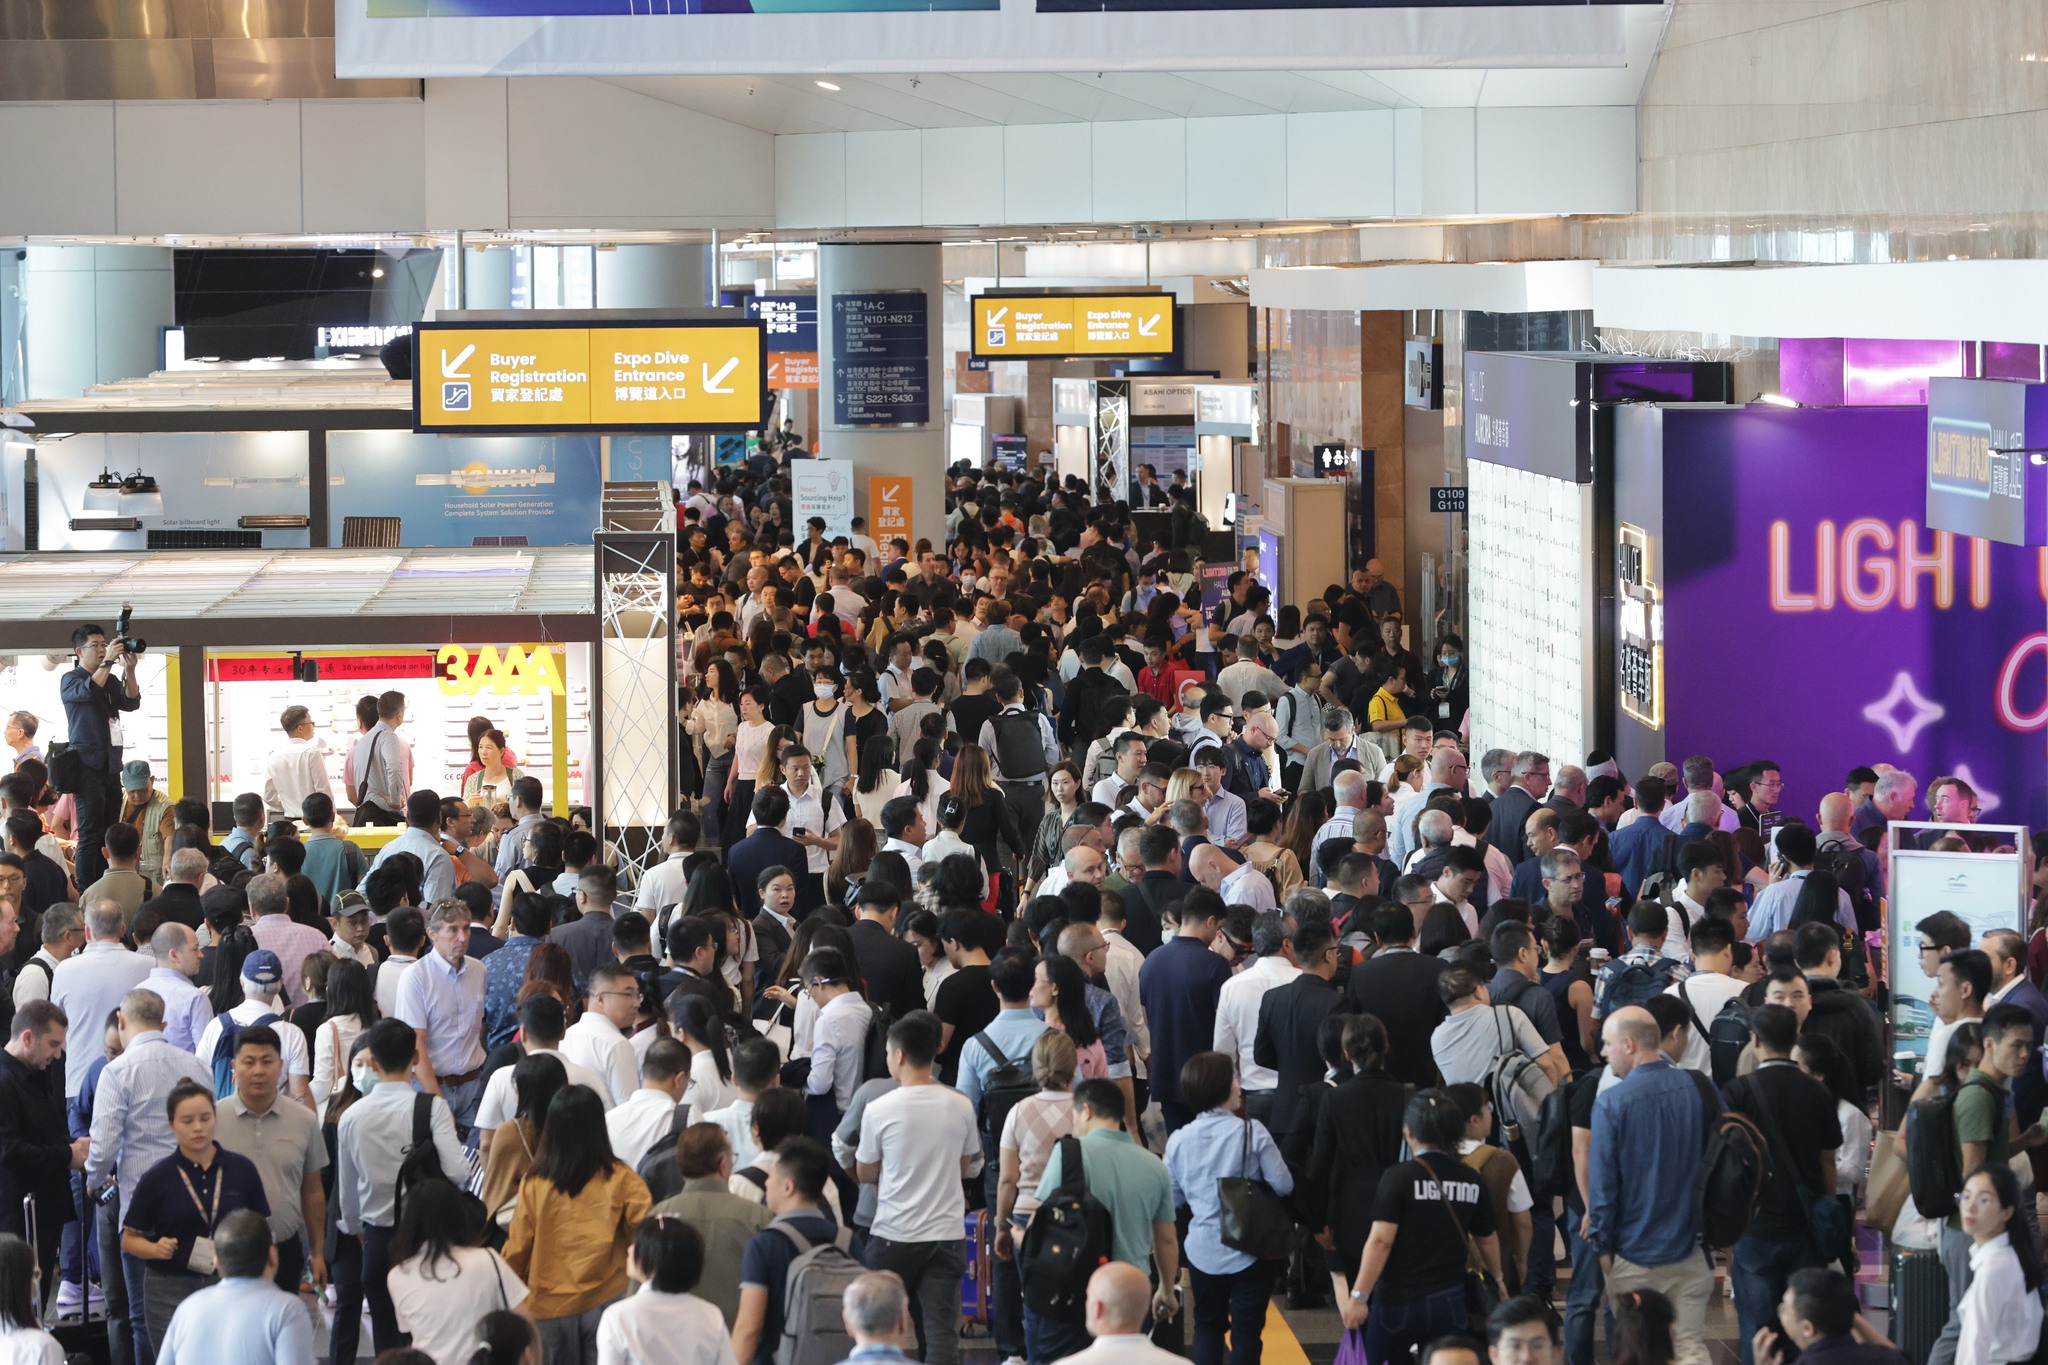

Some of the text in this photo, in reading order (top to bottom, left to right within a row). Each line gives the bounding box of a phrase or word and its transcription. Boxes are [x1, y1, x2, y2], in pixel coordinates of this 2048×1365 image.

[776, 302, 796, 310] 1A-B
[864, 302, 885, 310] 1A-C
[864, 315, 913, 324] N101-N212
[1015, 312, 1043, 322] Buyer
[1087, 310, 1132, 320] Expo Dive
[1015, 322, 1072, 332] Registration
[1087, 321, 1129, 330] Entrance
[490, 353, 536, 367] Buyer
[614, 352, 690, 366] Expo Dive
[784, 358, 810, 366] Buyer
[490, 370, 587, 384] Registration
[614, 369, 685, 382] Entrance
[490, 388, 563, 402] 買家登記處
[614, 387, 686, 400] 博覽道入口
[866, 395, 914, 403] S221-S430
[800, 494, 846, 502] Sourcing Help?
[1438, 489, 1464, 499] G109
[1438, 500, 1464, 510] G110
[444, 510, 475, 518] Complete
[476, 510, 500, 518] System
[528, 508, 554, 516] Provider
[882, 506, 900, 516] 買家
[878, 517, 905, 528] 登記處
[1214, 580, 1226, 588] HALL
[353, 664, 374, 672] years
[436, 644, 566, 696] 3AAA
